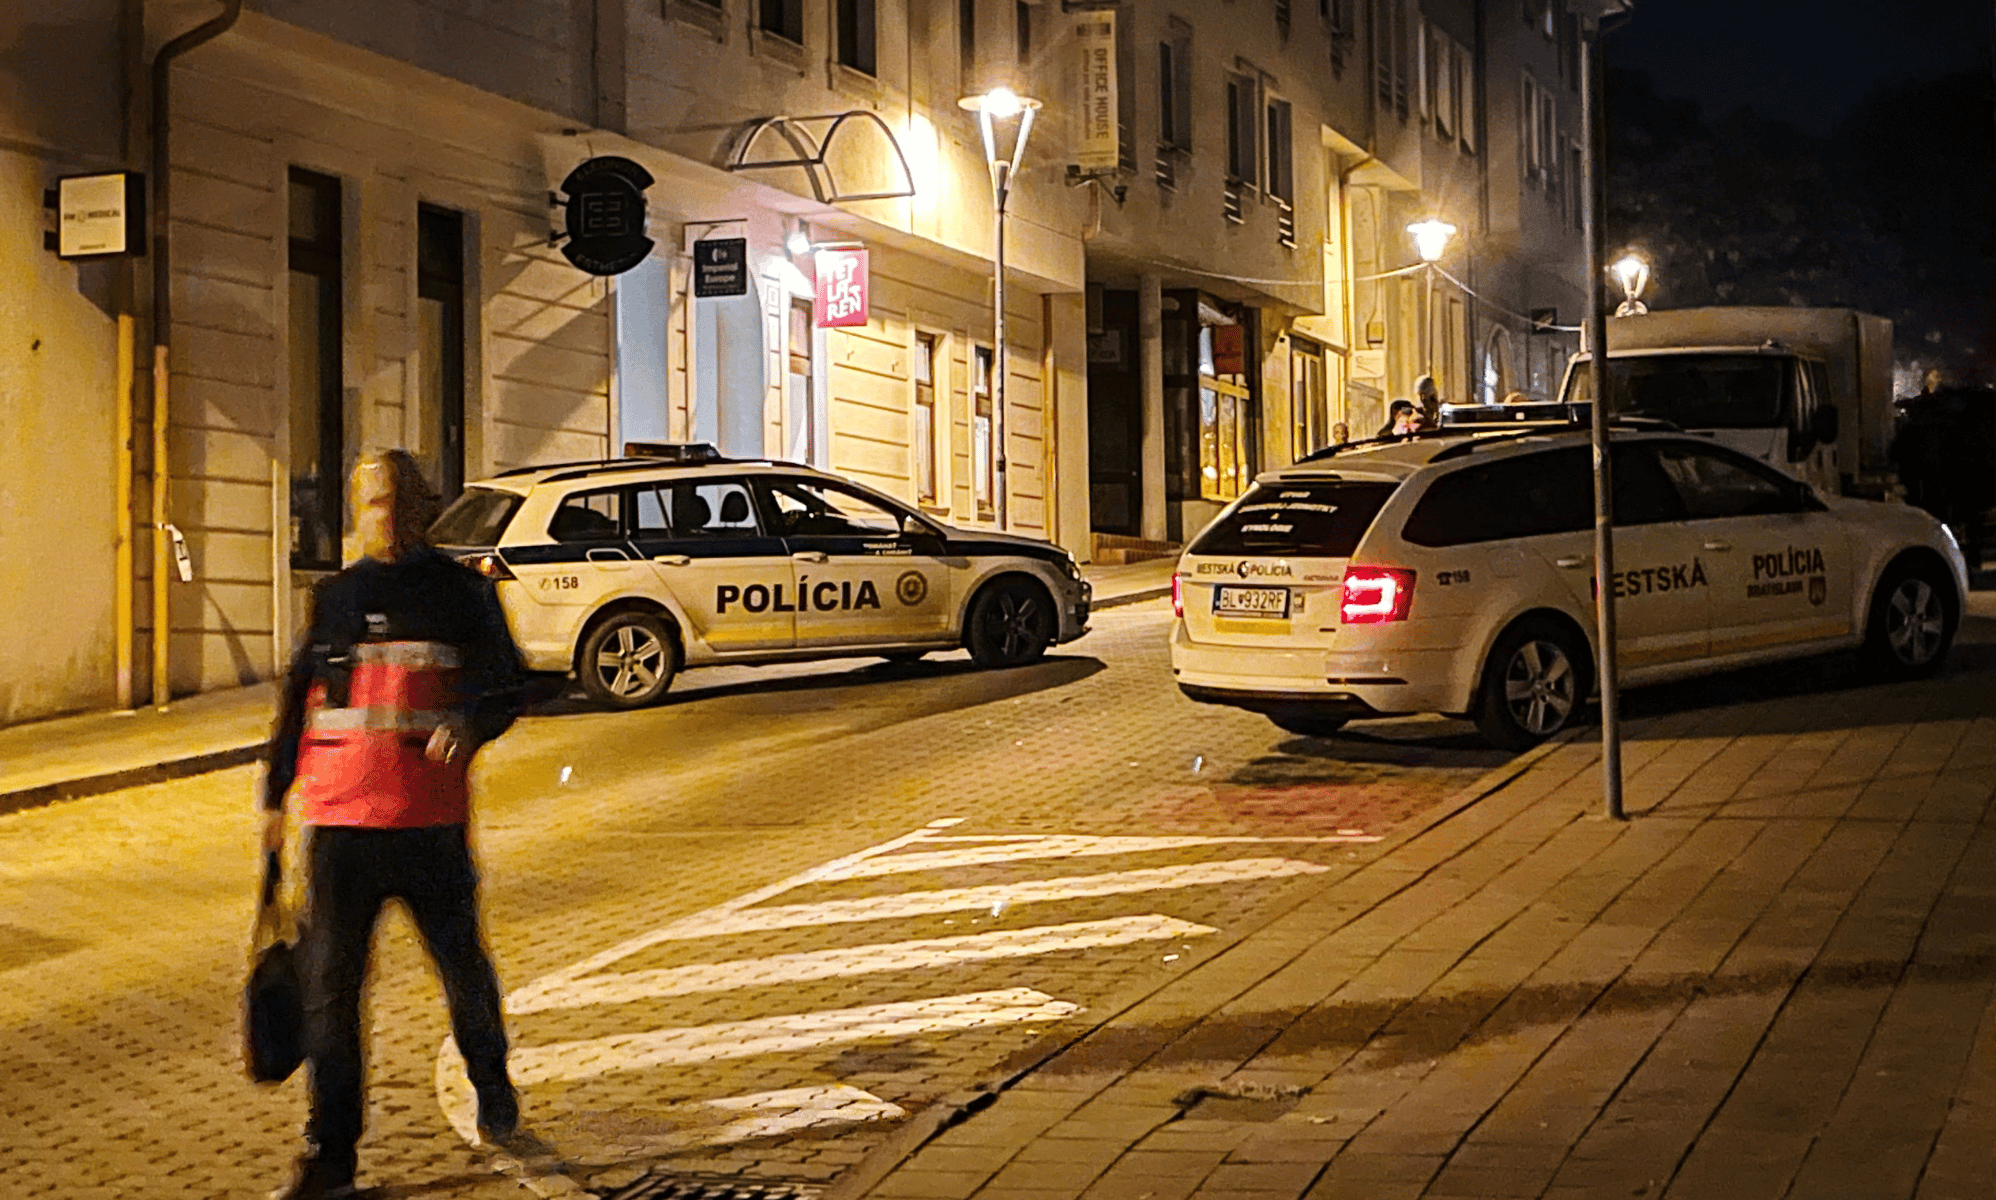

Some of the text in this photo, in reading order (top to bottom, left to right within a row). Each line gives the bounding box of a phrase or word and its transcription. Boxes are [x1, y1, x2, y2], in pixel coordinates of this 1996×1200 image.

[1094, 47, 1109, 93] OFFICE
[1095, 96, 1109, 139] HOUSE
[1590, 556, 1708, 601] ESTSKÁ
[1753, 545, 1826, 580] POLÍCIA
[553, 576, 579, 590] 158
[716, 575, 881, 613] POLÍCIA
[1221, 590, 1285, 609] BL 932RF
